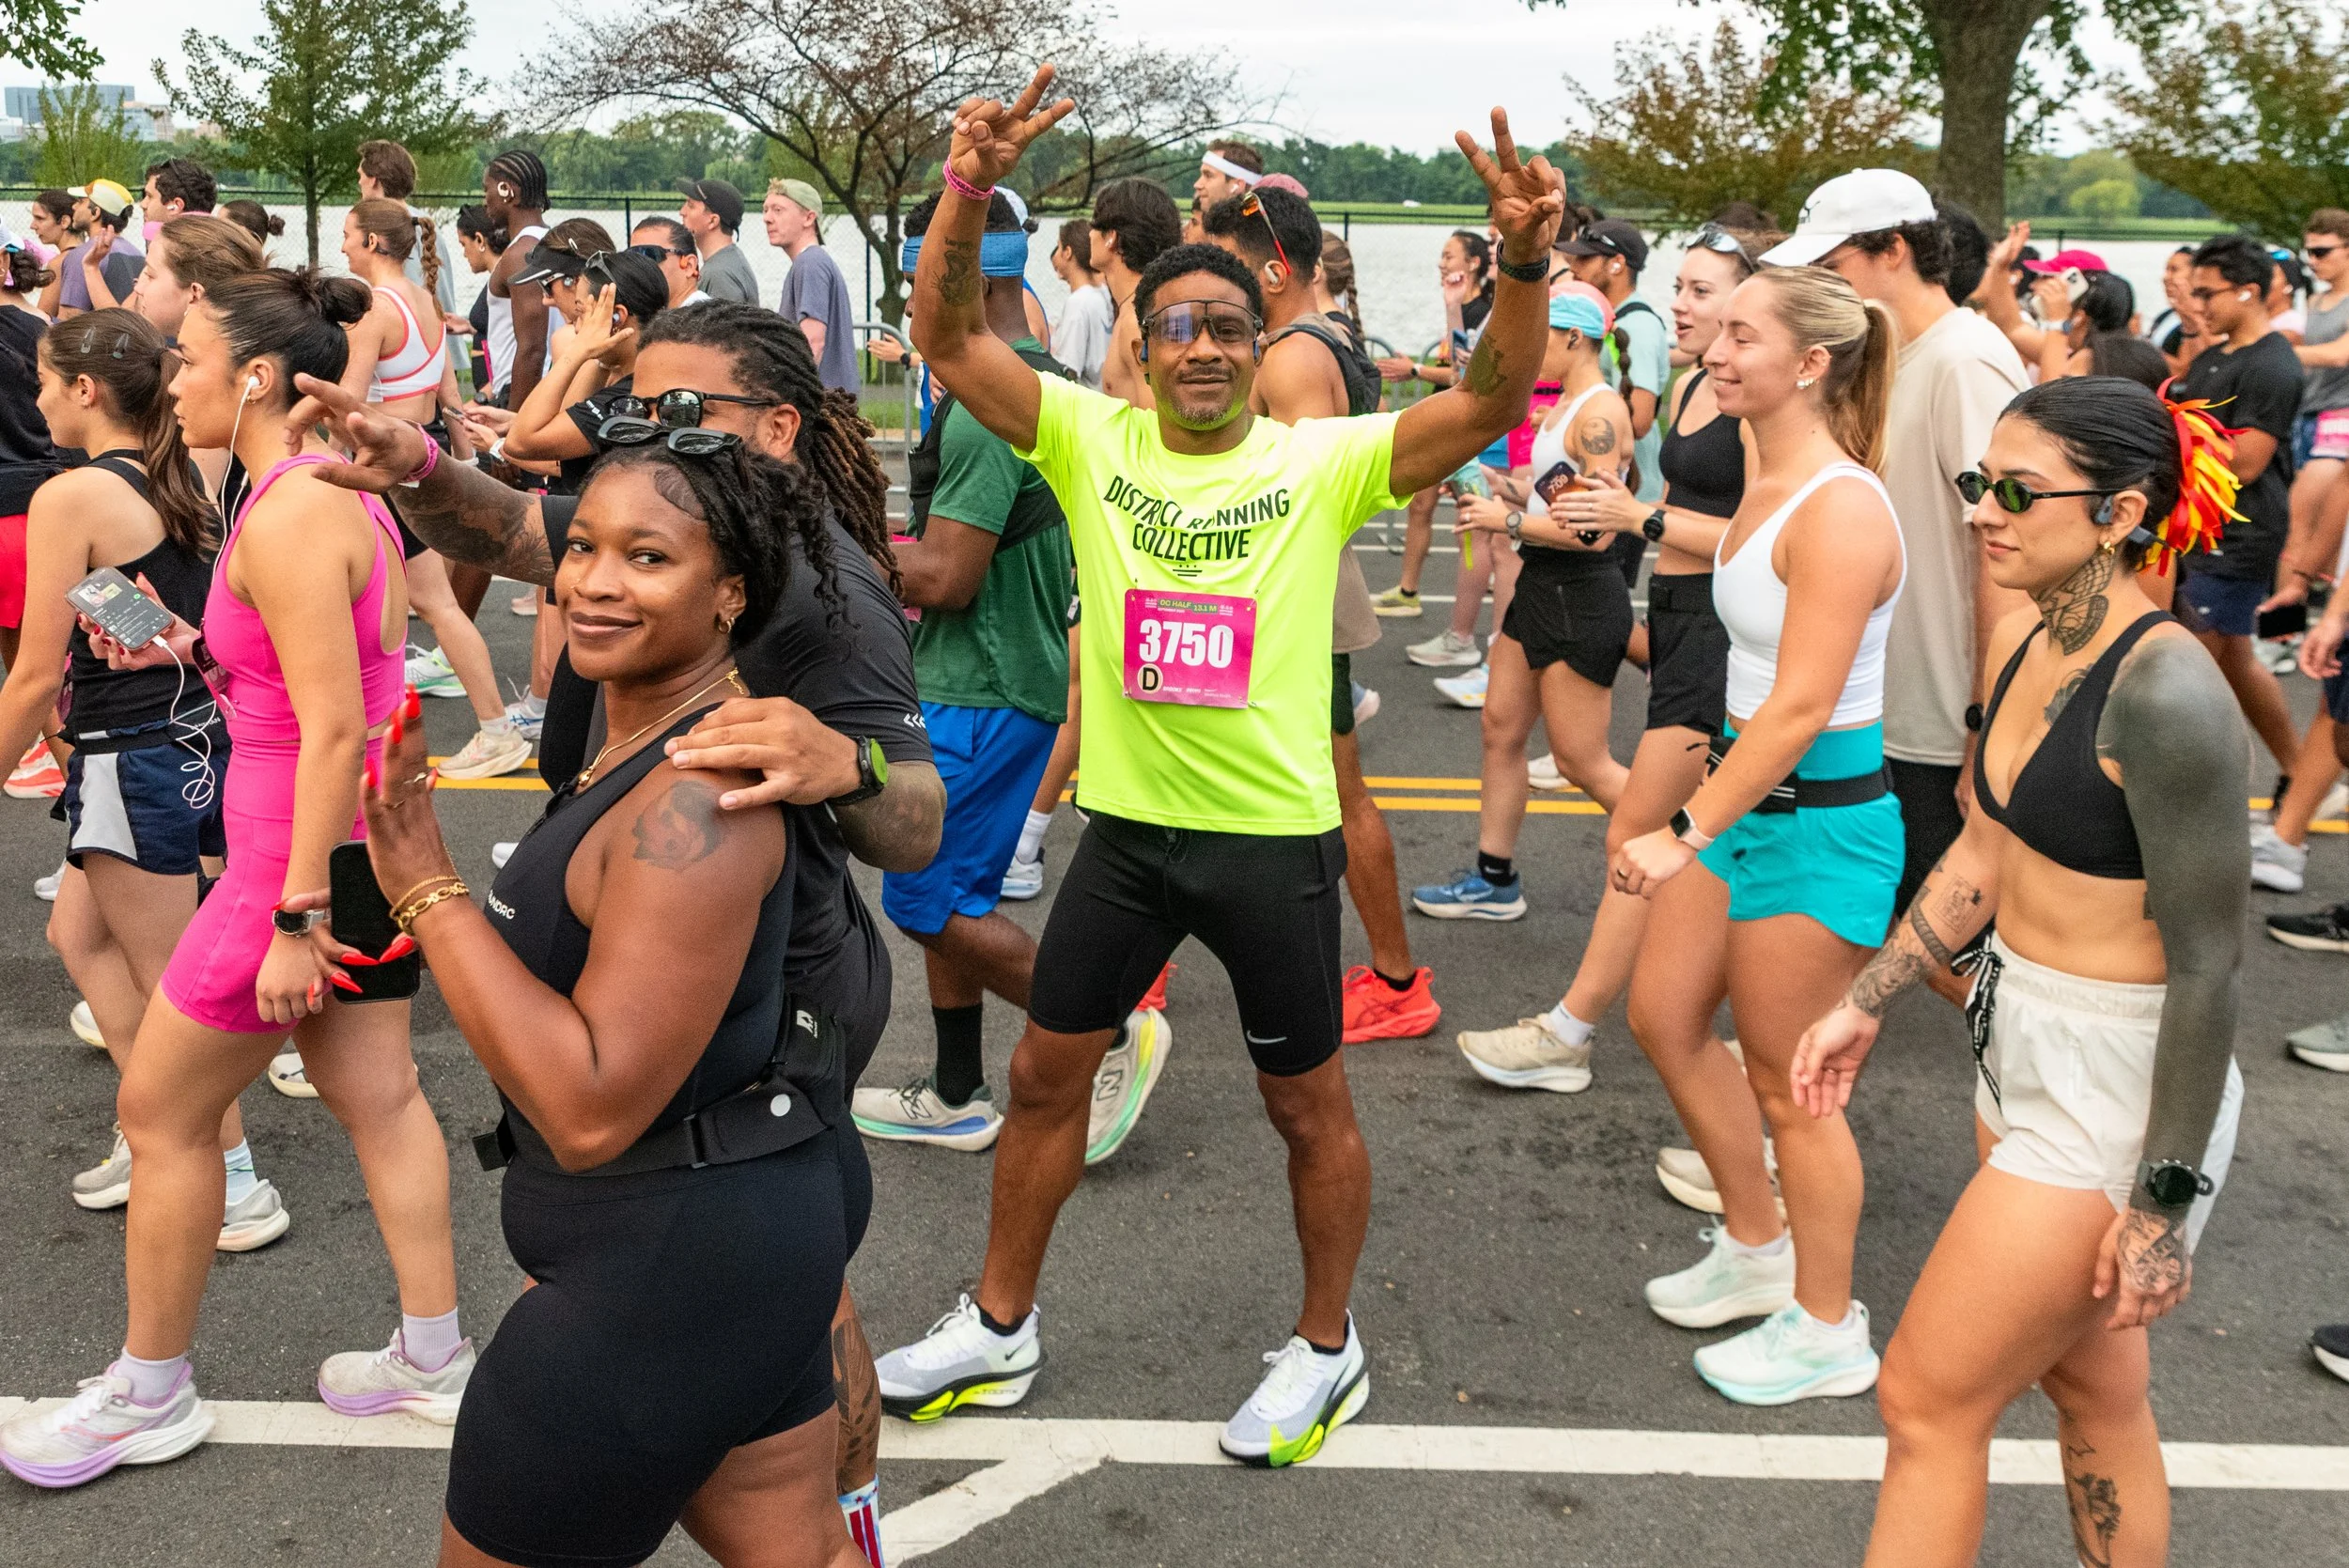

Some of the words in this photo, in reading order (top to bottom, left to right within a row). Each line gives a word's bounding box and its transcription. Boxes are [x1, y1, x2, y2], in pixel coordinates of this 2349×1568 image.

[1132, 522, 1252, 561] COLLECTIVE
[1172, 600, 1192, 609] HALF
[1139, 618, 1234, 668] 3750
[1143, 666, 1159, 691] D
